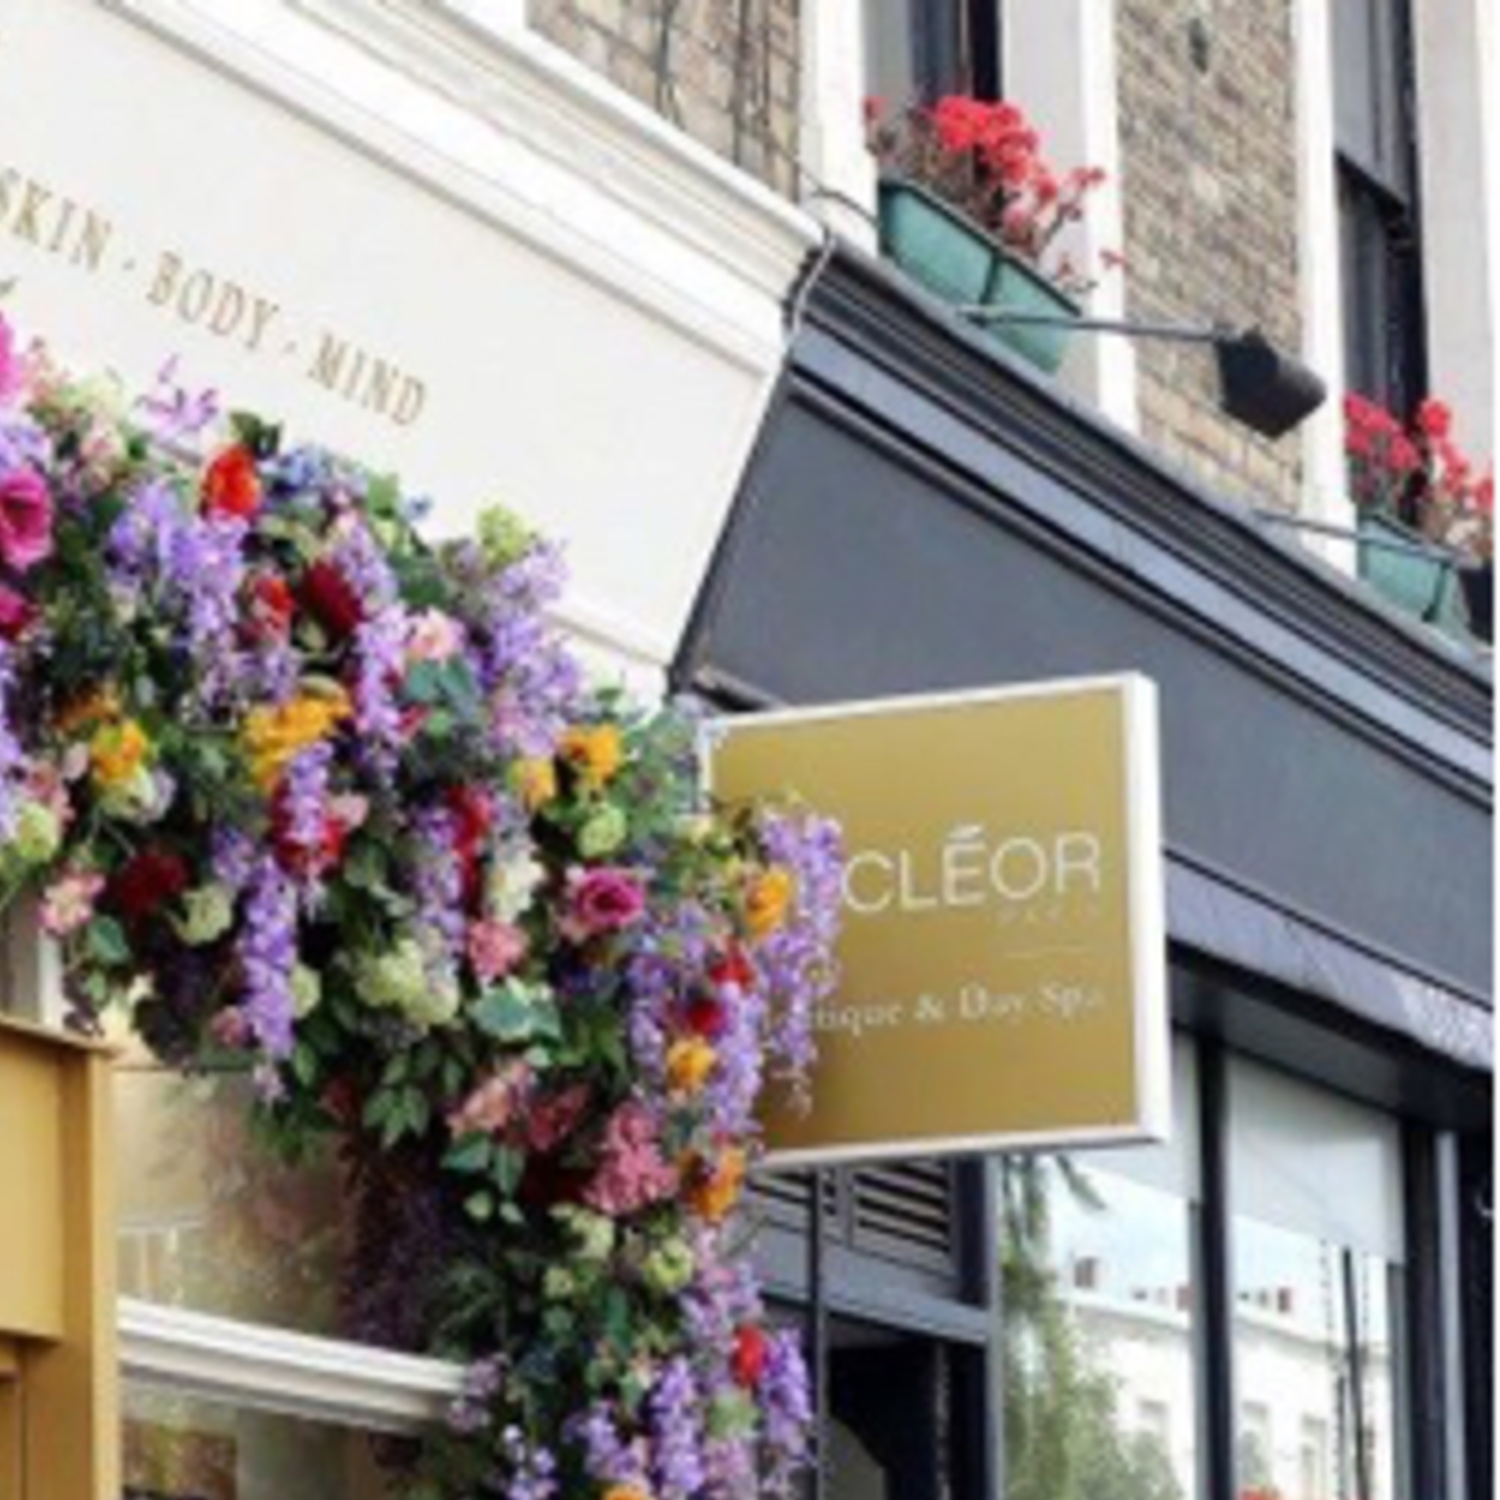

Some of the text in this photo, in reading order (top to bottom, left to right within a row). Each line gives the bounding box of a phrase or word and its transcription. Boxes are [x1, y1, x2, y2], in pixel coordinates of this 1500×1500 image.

[145, 249, 280, 350] BODY
[307, 332, 427, 427] MIND
[840, 824, 1101, 913] CLÉOR
